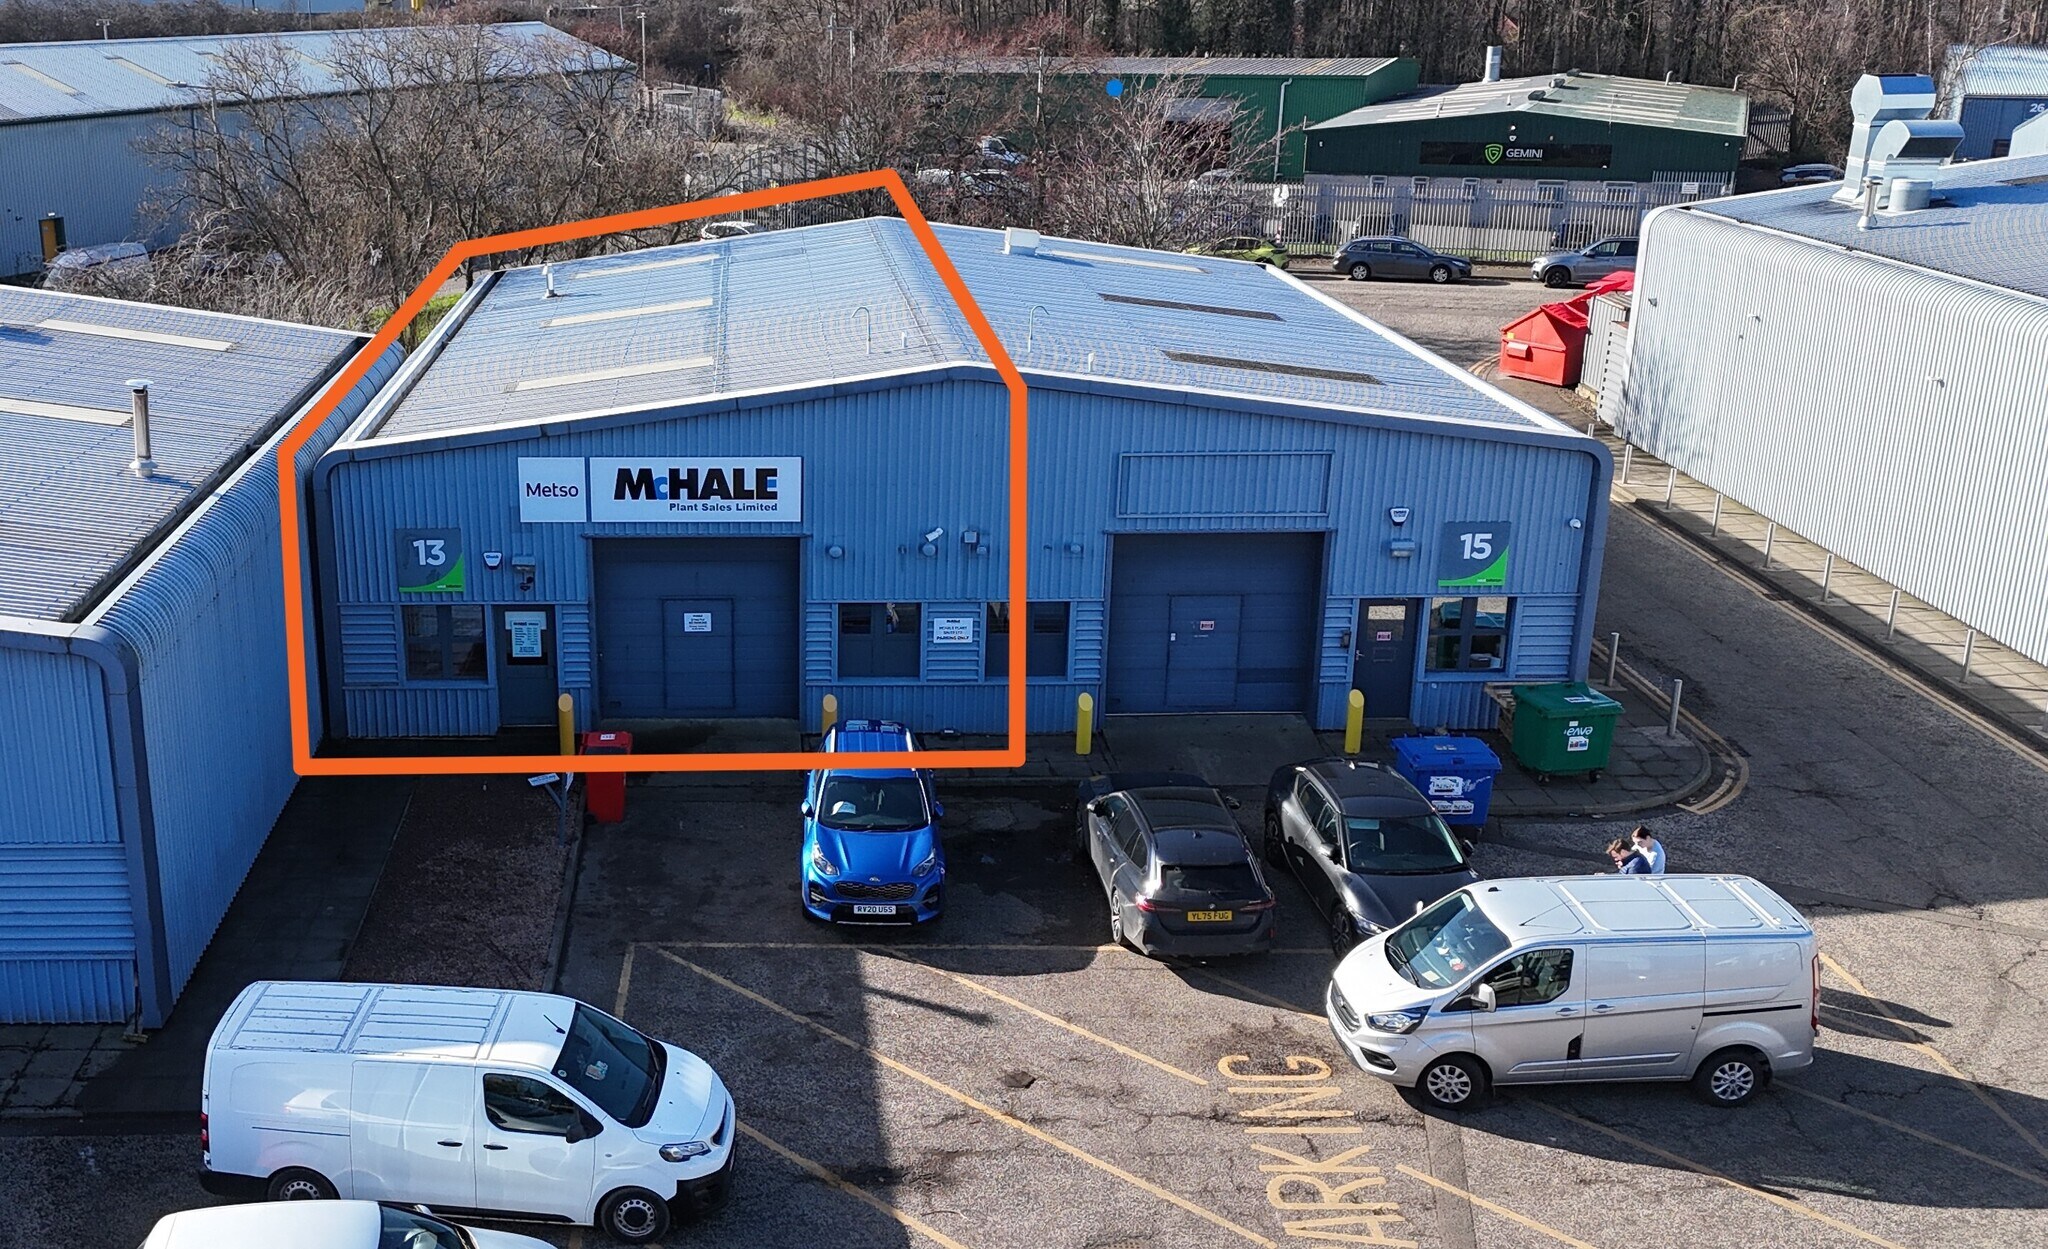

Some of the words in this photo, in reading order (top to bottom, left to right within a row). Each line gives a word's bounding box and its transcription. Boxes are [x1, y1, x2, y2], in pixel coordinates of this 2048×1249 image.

[2030, 103, 2045, 112] 26
[1506, 148, 1543, 159] GEMINI
[525, 482, 579, 497] Metso
[613, 468, 778, 500] McHALE
[669, 503, 698, 511] Plant
[701, 503, 732, 511] Sales
[736, 503, 778, 511] Limited
[412, 539, 446, 566] 13
[1460, 533, 1493, 560] 15
[1218, 1055, 1419, 1249] ARKING
